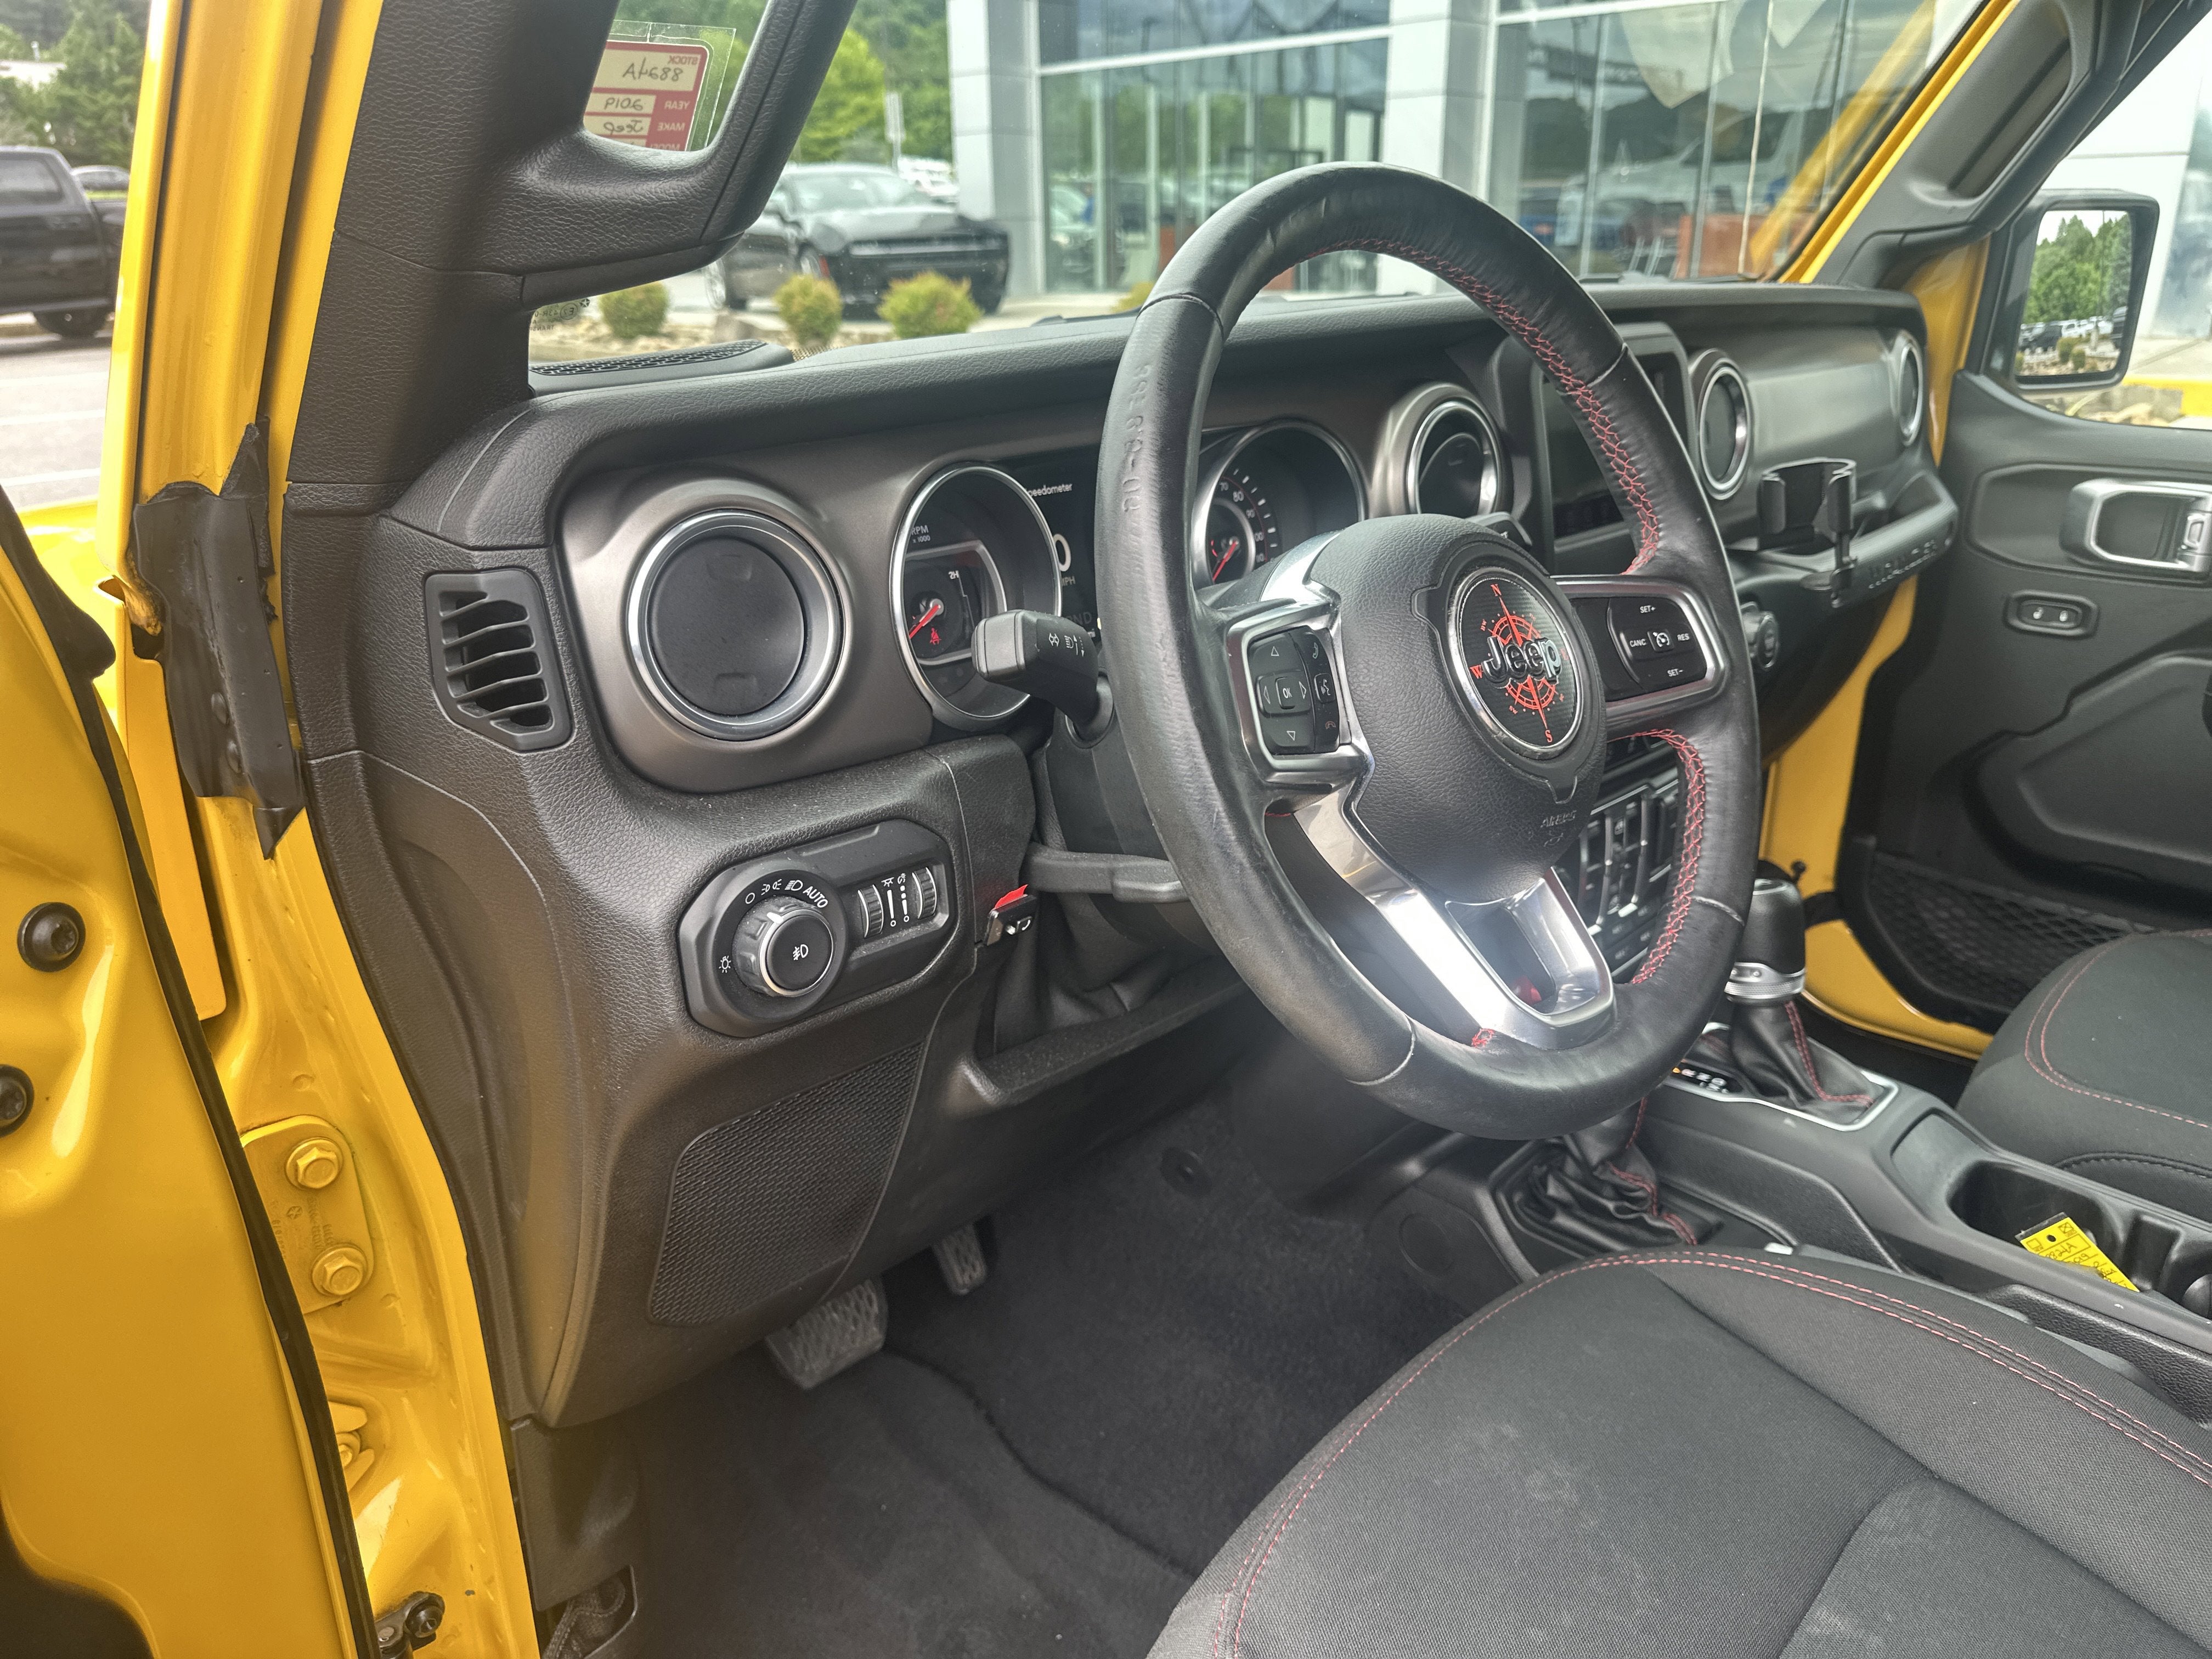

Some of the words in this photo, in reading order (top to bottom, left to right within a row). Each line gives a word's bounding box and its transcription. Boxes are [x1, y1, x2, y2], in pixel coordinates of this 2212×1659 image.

[1025, 483, 1073, 496] peedometer
[1233, 491, 1244, 502] 80
[911, 525, 929, 535] RPM
[918, 534, 931, 543] 1000
[948, 571, 959, 580] 2H
[1490, 584, 1502, 596] N
[1677, 633, 1690, 641] RES
[1629, 639, 1646, 647] CANC
[1482, 635, 1562, 684] Jeep
[1470, 664, 1483, 679] W
[1283, 687, 1293, 698] OK
[1544, 730, 1552, 743] S
[803, 886, 828, 908] AUTO
